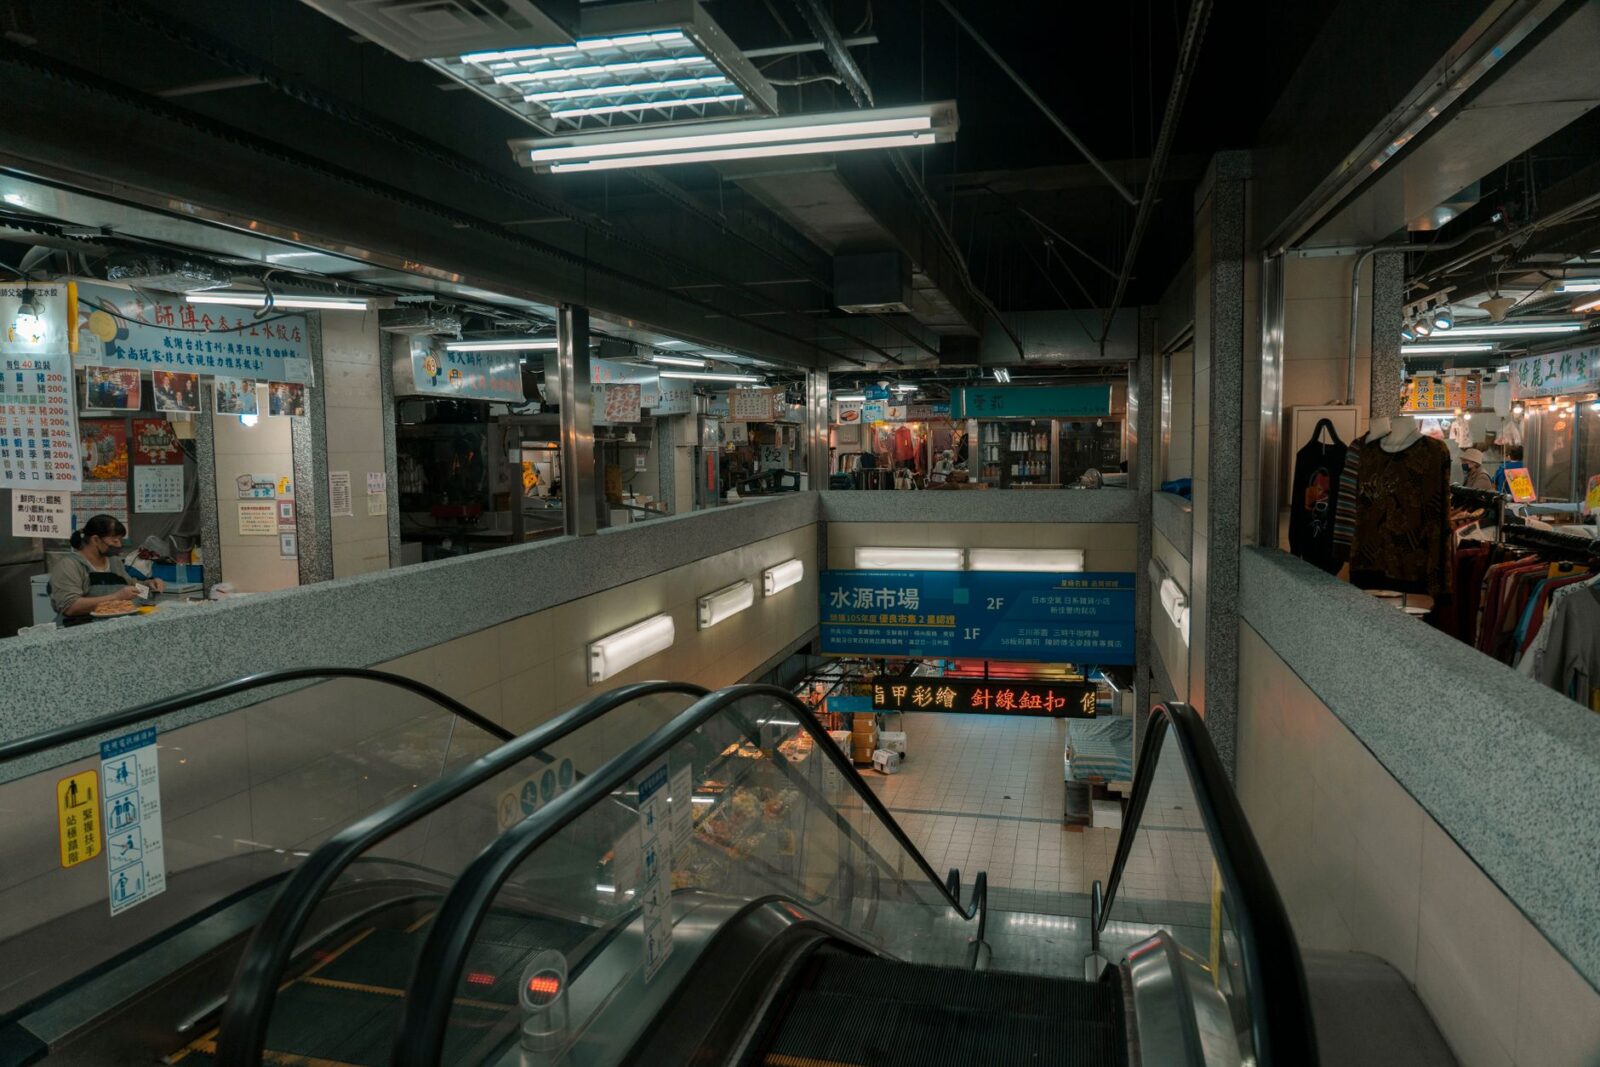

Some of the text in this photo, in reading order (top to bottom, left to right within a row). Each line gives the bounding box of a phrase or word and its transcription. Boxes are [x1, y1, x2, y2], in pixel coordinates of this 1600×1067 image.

[22, 361, 32, 369] 40
[829, 586, 920, 610] 水源市場
[986, 597, 1005, 610] 2F
[963, 627, 981, 640] 1F
[970, 687, 1067, 712] 針線鈕扣
